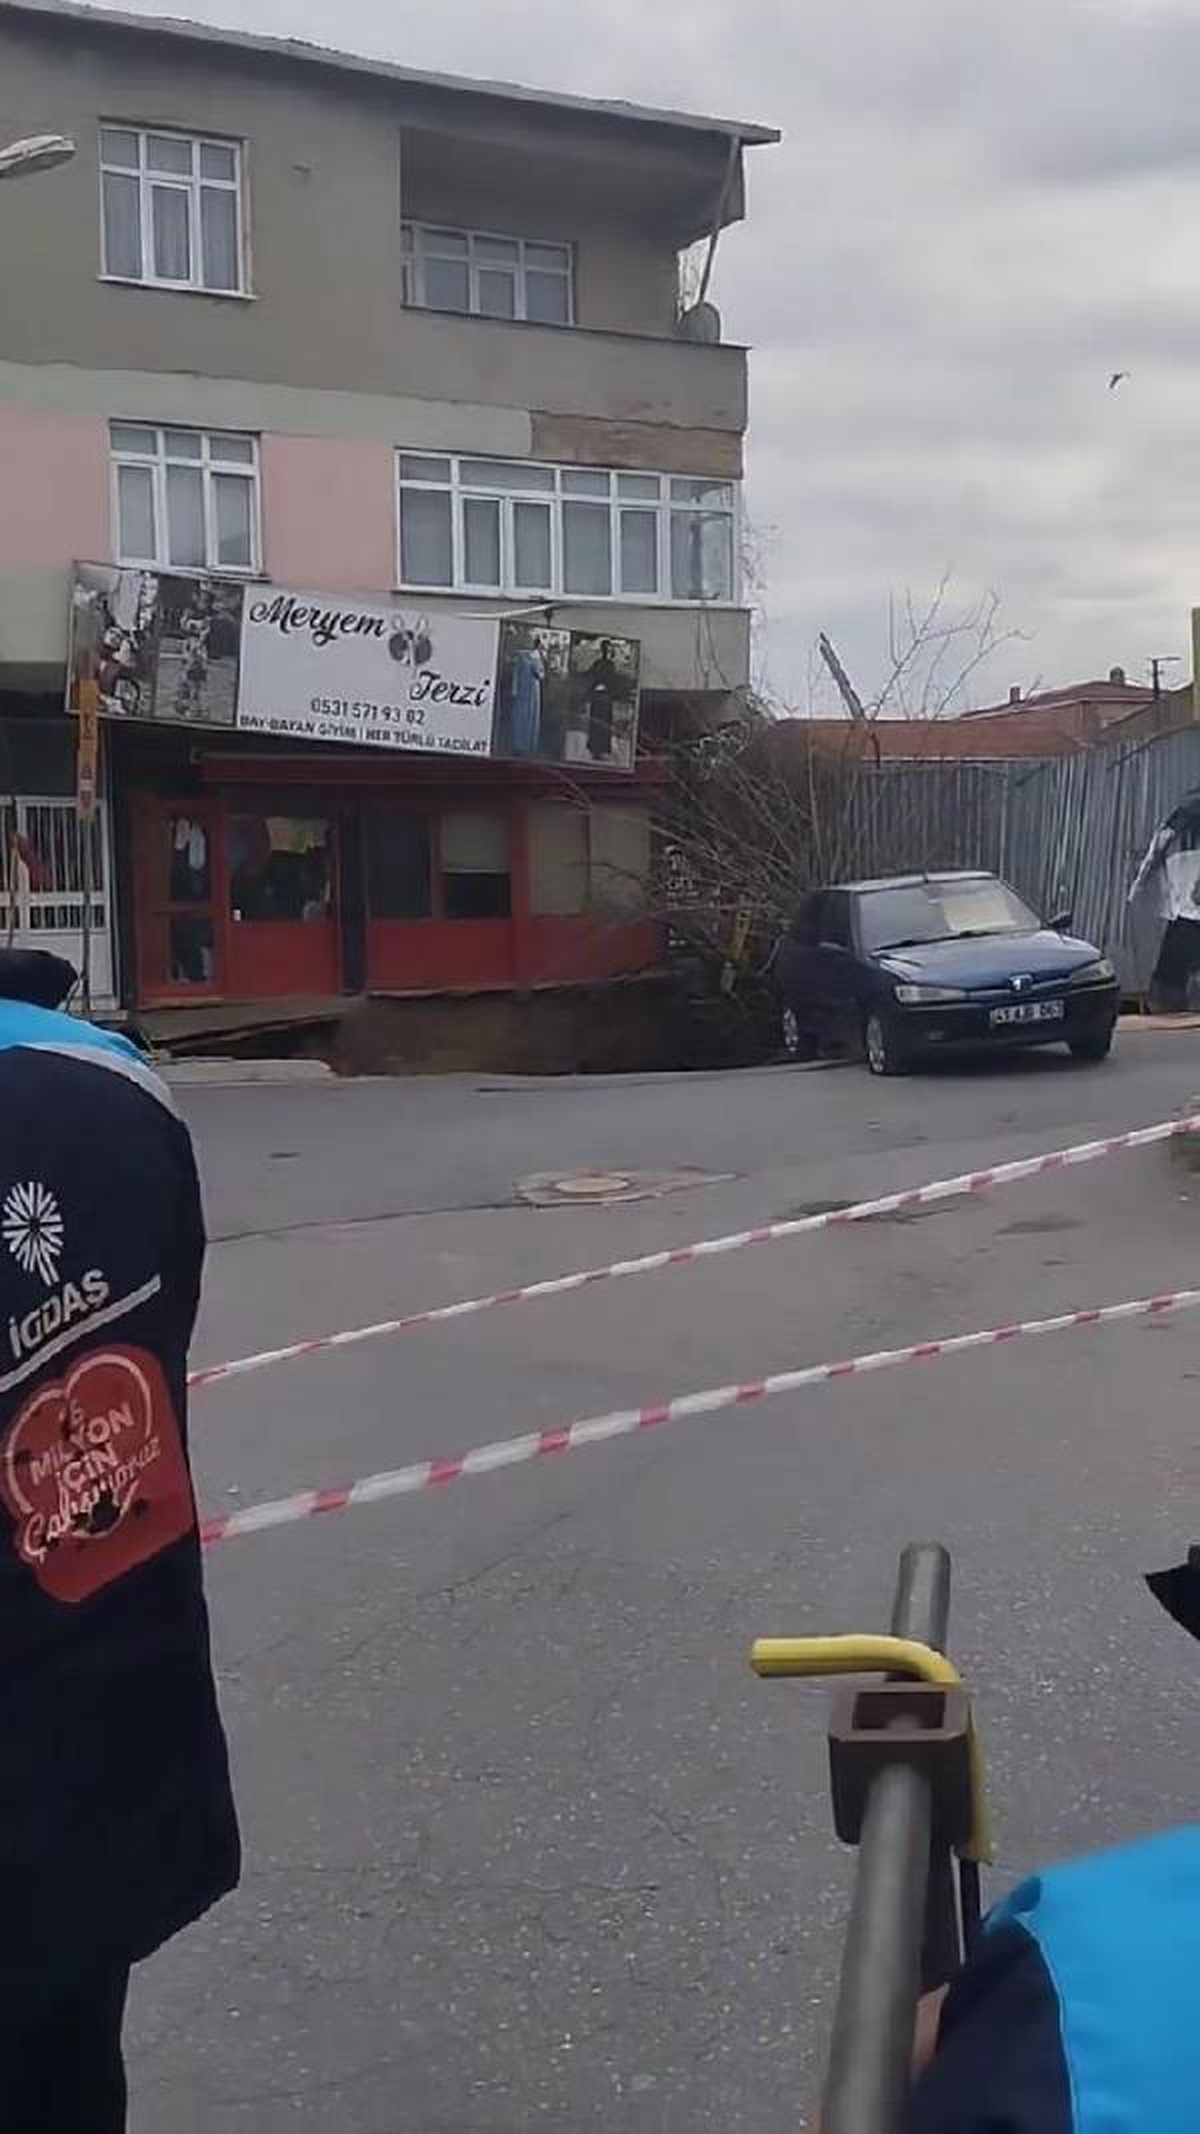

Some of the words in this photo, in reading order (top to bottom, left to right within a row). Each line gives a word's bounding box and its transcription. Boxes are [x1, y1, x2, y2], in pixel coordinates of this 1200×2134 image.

[250, 595, 386, 646] Meryem
[410, 670, 490, 706] Terzi
[311, 698, 348, 717] 0531
[352, 702, 378, 718] 571
[381, 705, 401, 723] 93
[406, 709, 425, 725] 02
[366, 729, 390, 741] HER
[393, 730, 435, 747] TÜRLÜ
